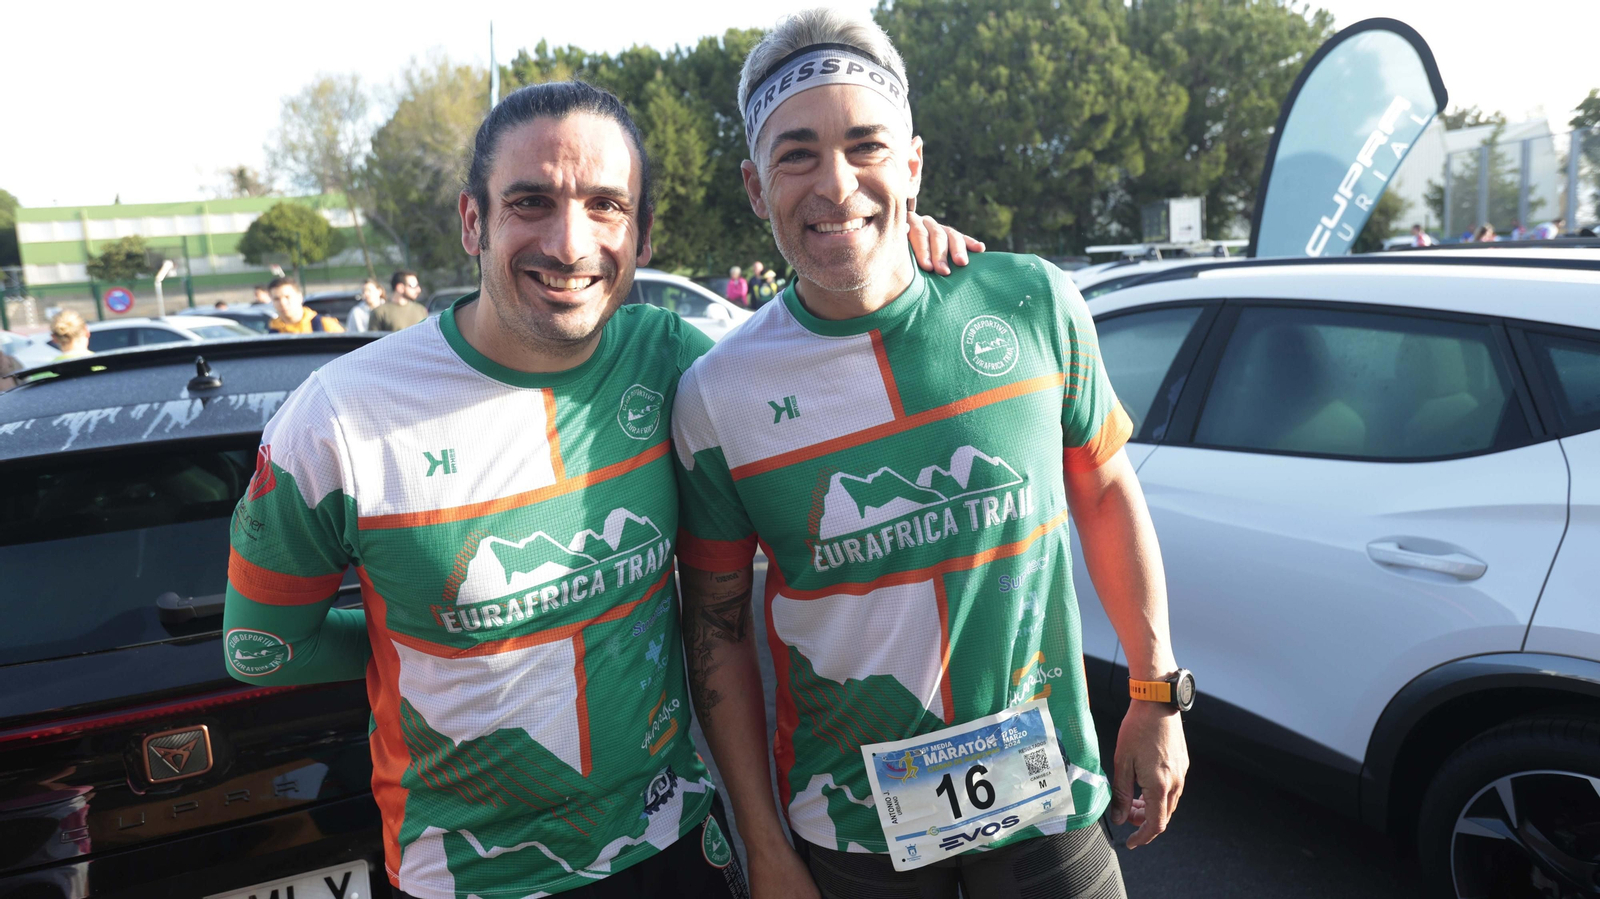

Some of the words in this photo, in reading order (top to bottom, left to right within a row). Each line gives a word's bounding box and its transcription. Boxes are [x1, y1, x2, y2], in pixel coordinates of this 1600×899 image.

[1305, 95, 1412, 258] CUPRA
[1327, 113, 1430, 253] URIAL
[974, 320, 1007, 335] DEPORTIVO
[813, 507, 959, 573] EURAFRICA
[963, 485, 1034, 532] TRAIL
[440, 569, 606, 634] EURAFRICA
[614, 537, 672, 589] TRAIL
[229, 635, 240, 649] CLUB
[239, 633, 276, 648] DEPORTIV
[1002, 730, 1028, 745] MARZO
[1009, 726, 1019, 736] DE
[922, 735, 999, 767] MARATÓN
[930, 741, 953, 752] MEDIA
[1003, 739, 1021, 750] 2024
[1018, 740, 1047, 754] RESULTADOS
[935, 764, 996, 820] 16
[1038, 779, 1048, 790] M
[884, 797, 899, 825] ANTONIO
[938, 815, 1020, 851] EVOS
